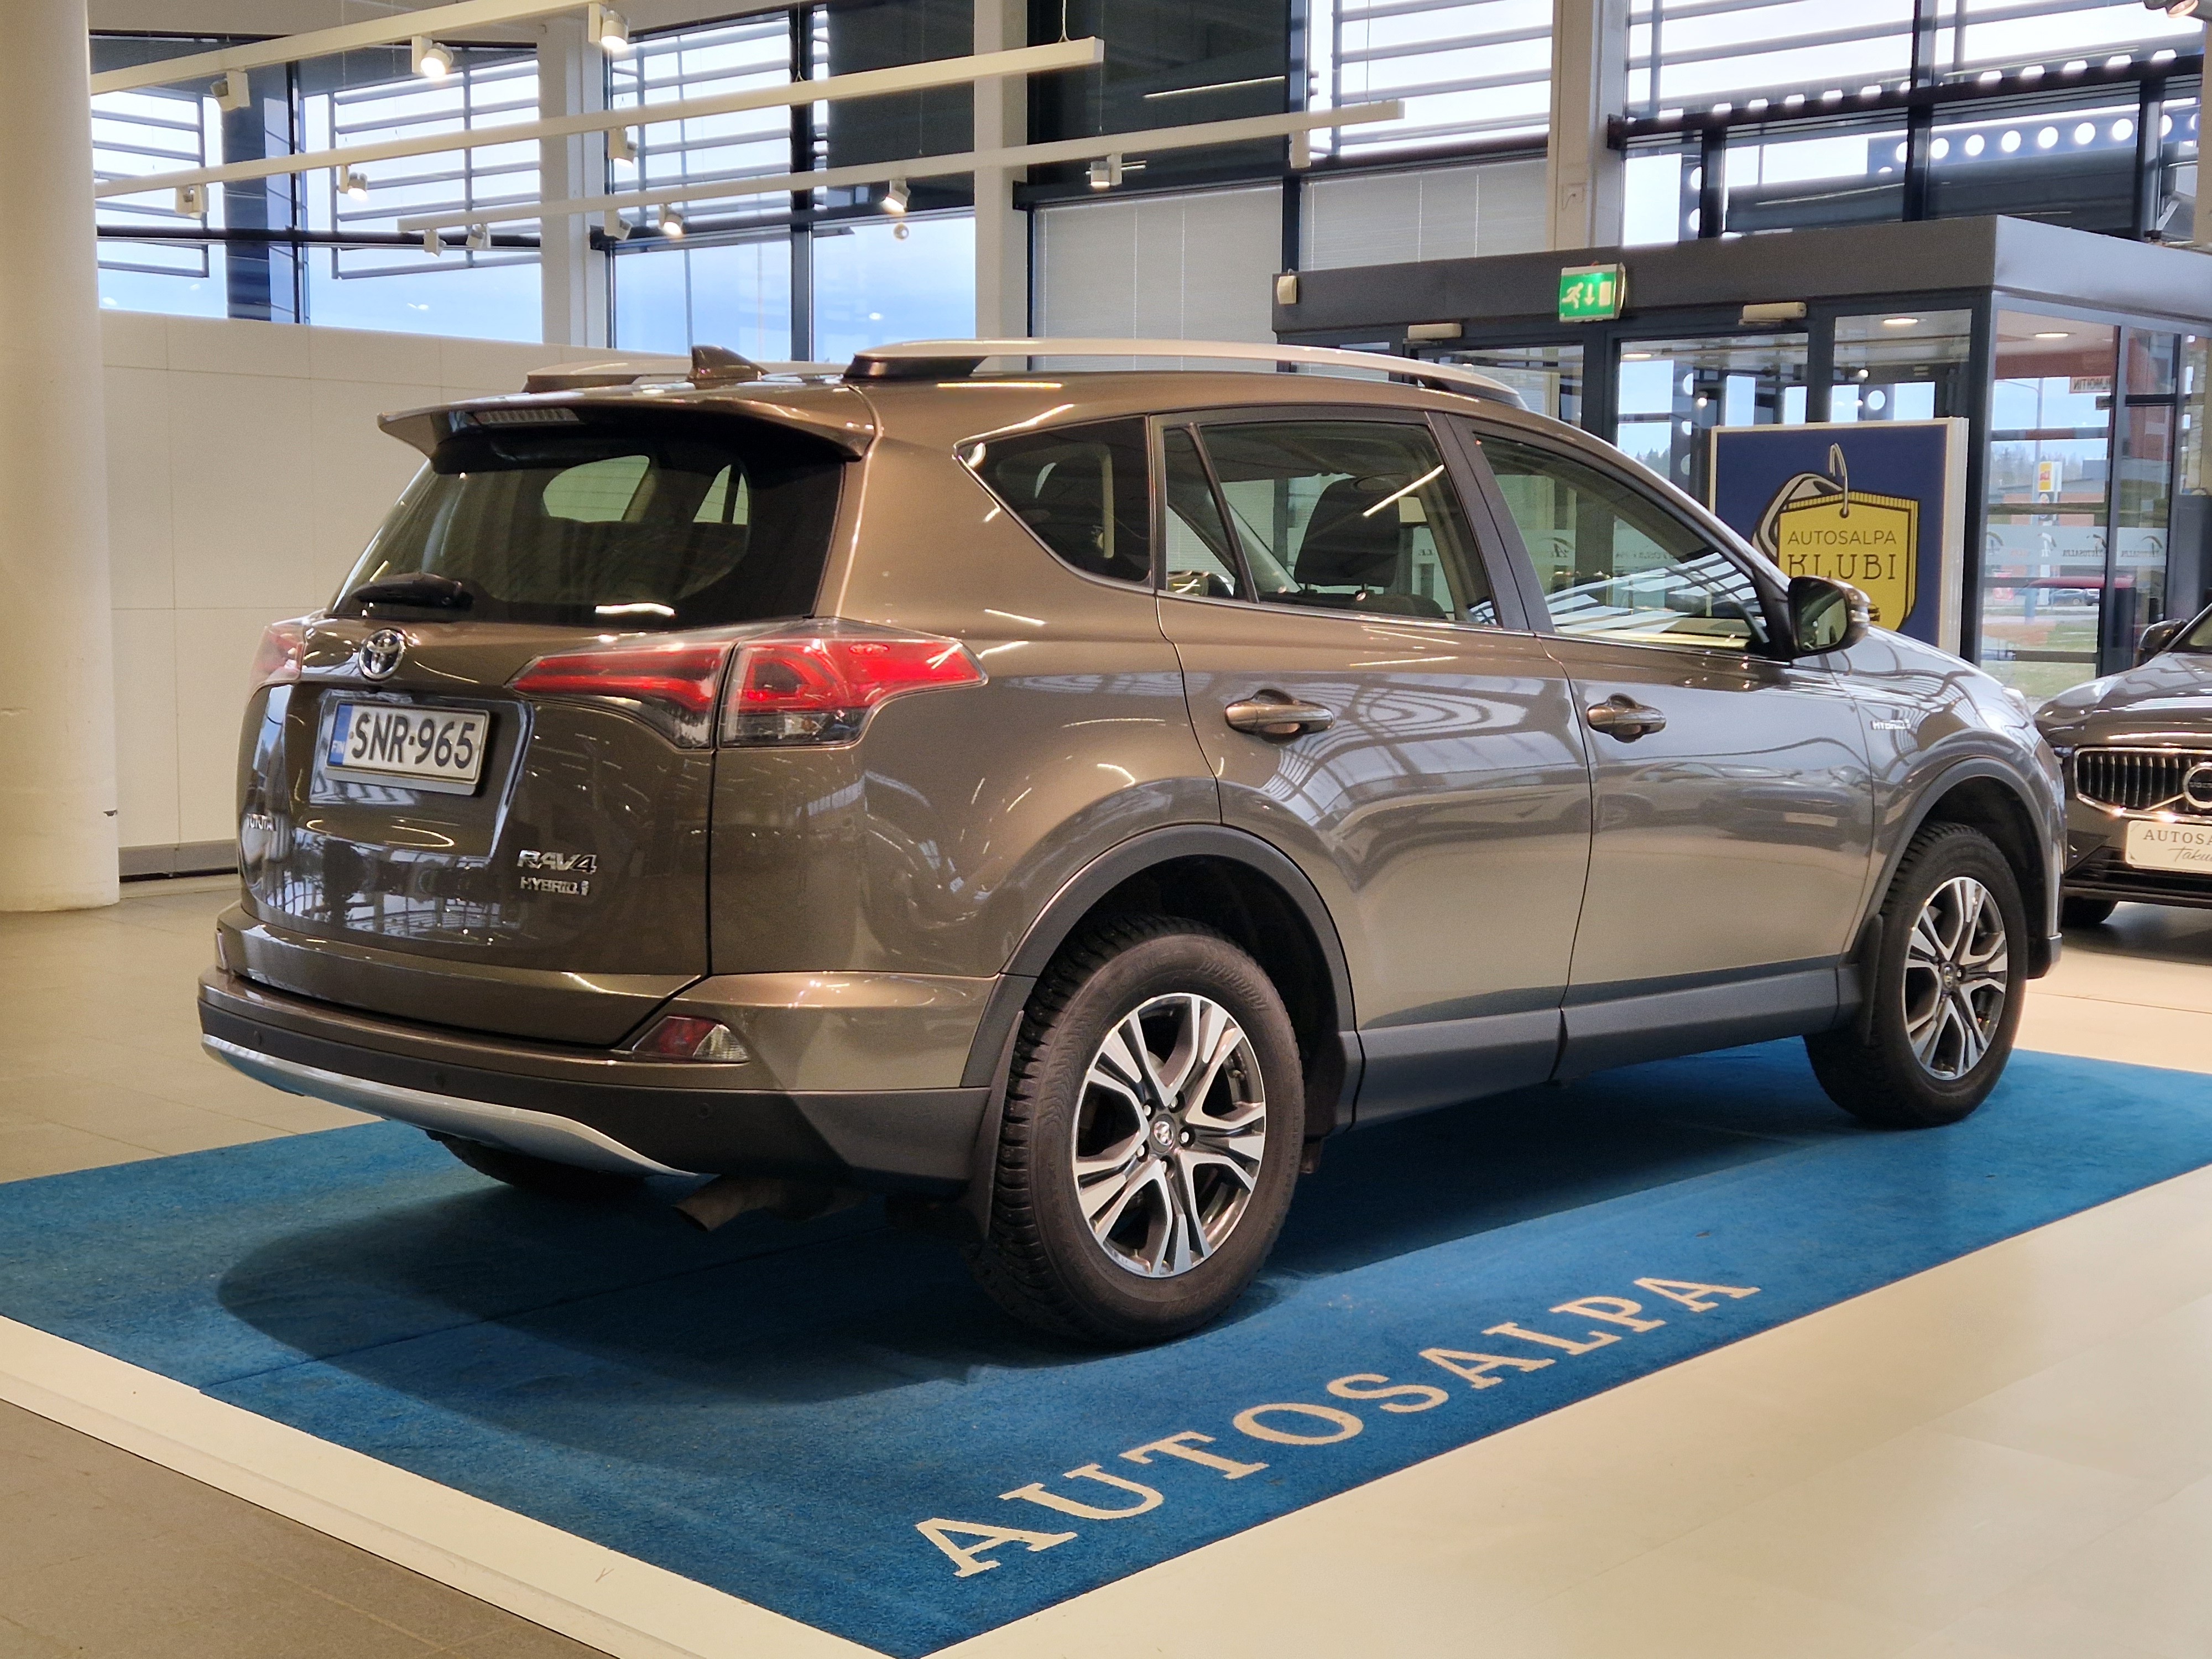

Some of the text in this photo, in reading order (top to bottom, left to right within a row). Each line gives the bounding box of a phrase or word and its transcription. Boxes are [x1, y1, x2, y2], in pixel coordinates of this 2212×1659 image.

[1787, 530, 1897, 545] AUTOSALPA
[1787, 554, 1896, 580] KLUBI
[517, 849, 597, 874] RAV4
[2168, 847, 2212, 862] Taku
[520, 876, 578, 895] HYBRID
[915, 1277, 1761, 1578] AUTOSALPA
